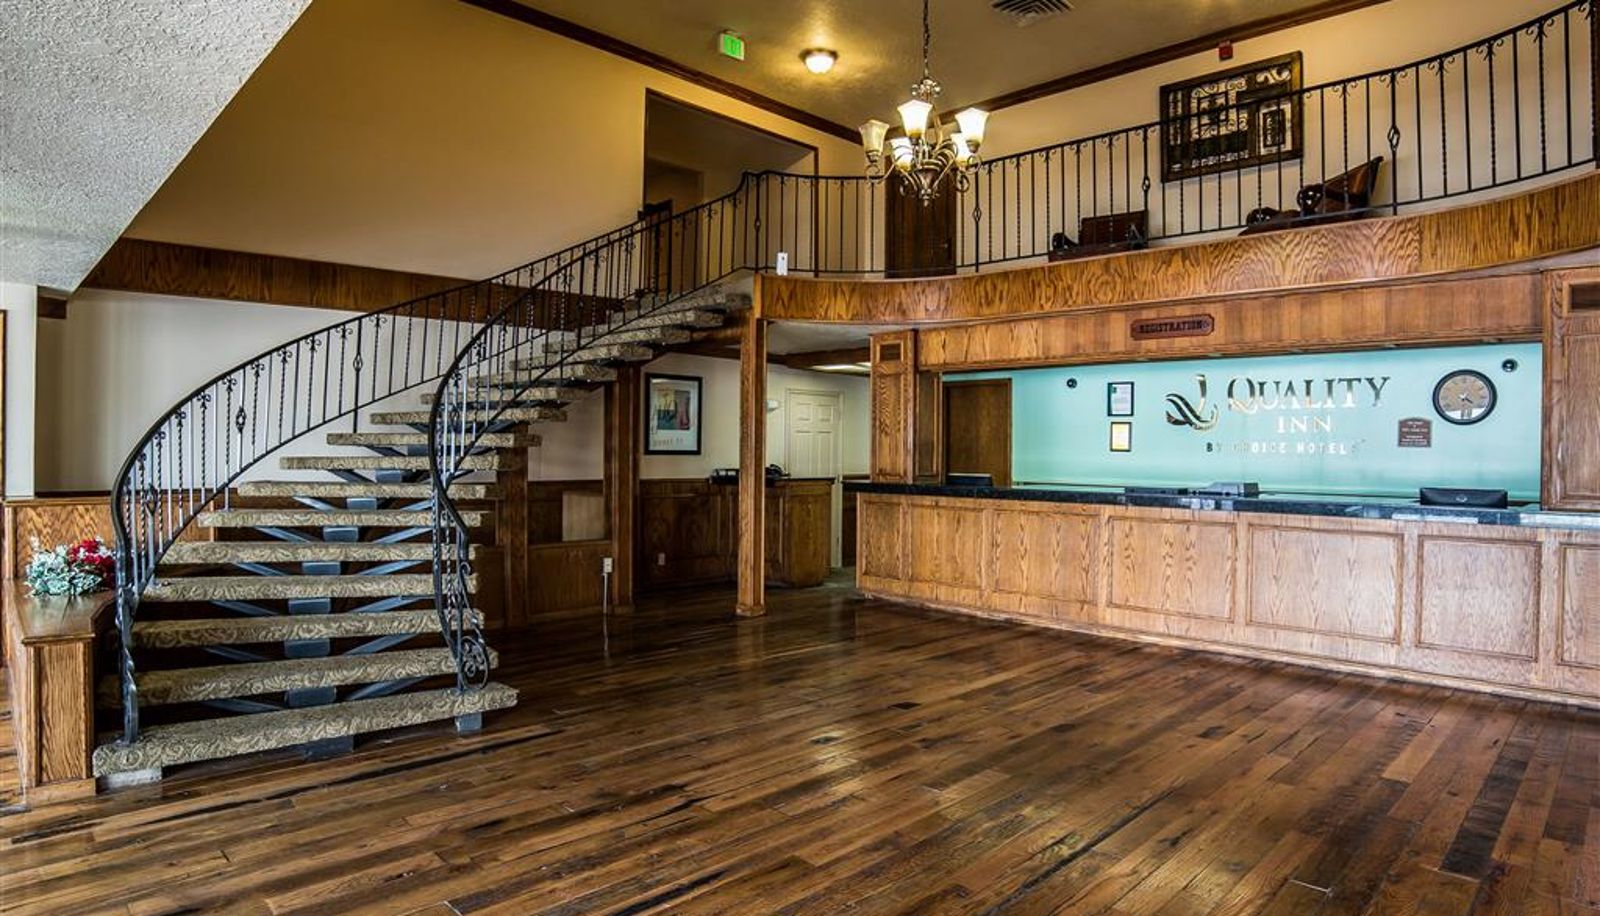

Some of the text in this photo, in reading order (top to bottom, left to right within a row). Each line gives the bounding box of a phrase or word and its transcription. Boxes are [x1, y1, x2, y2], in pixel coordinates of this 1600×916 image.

[1137, 320, 1203, 334] REGISTRATION
[1226, 376, 1391, 415] QUALITY
[1277, 415, 1331, 433] INN
